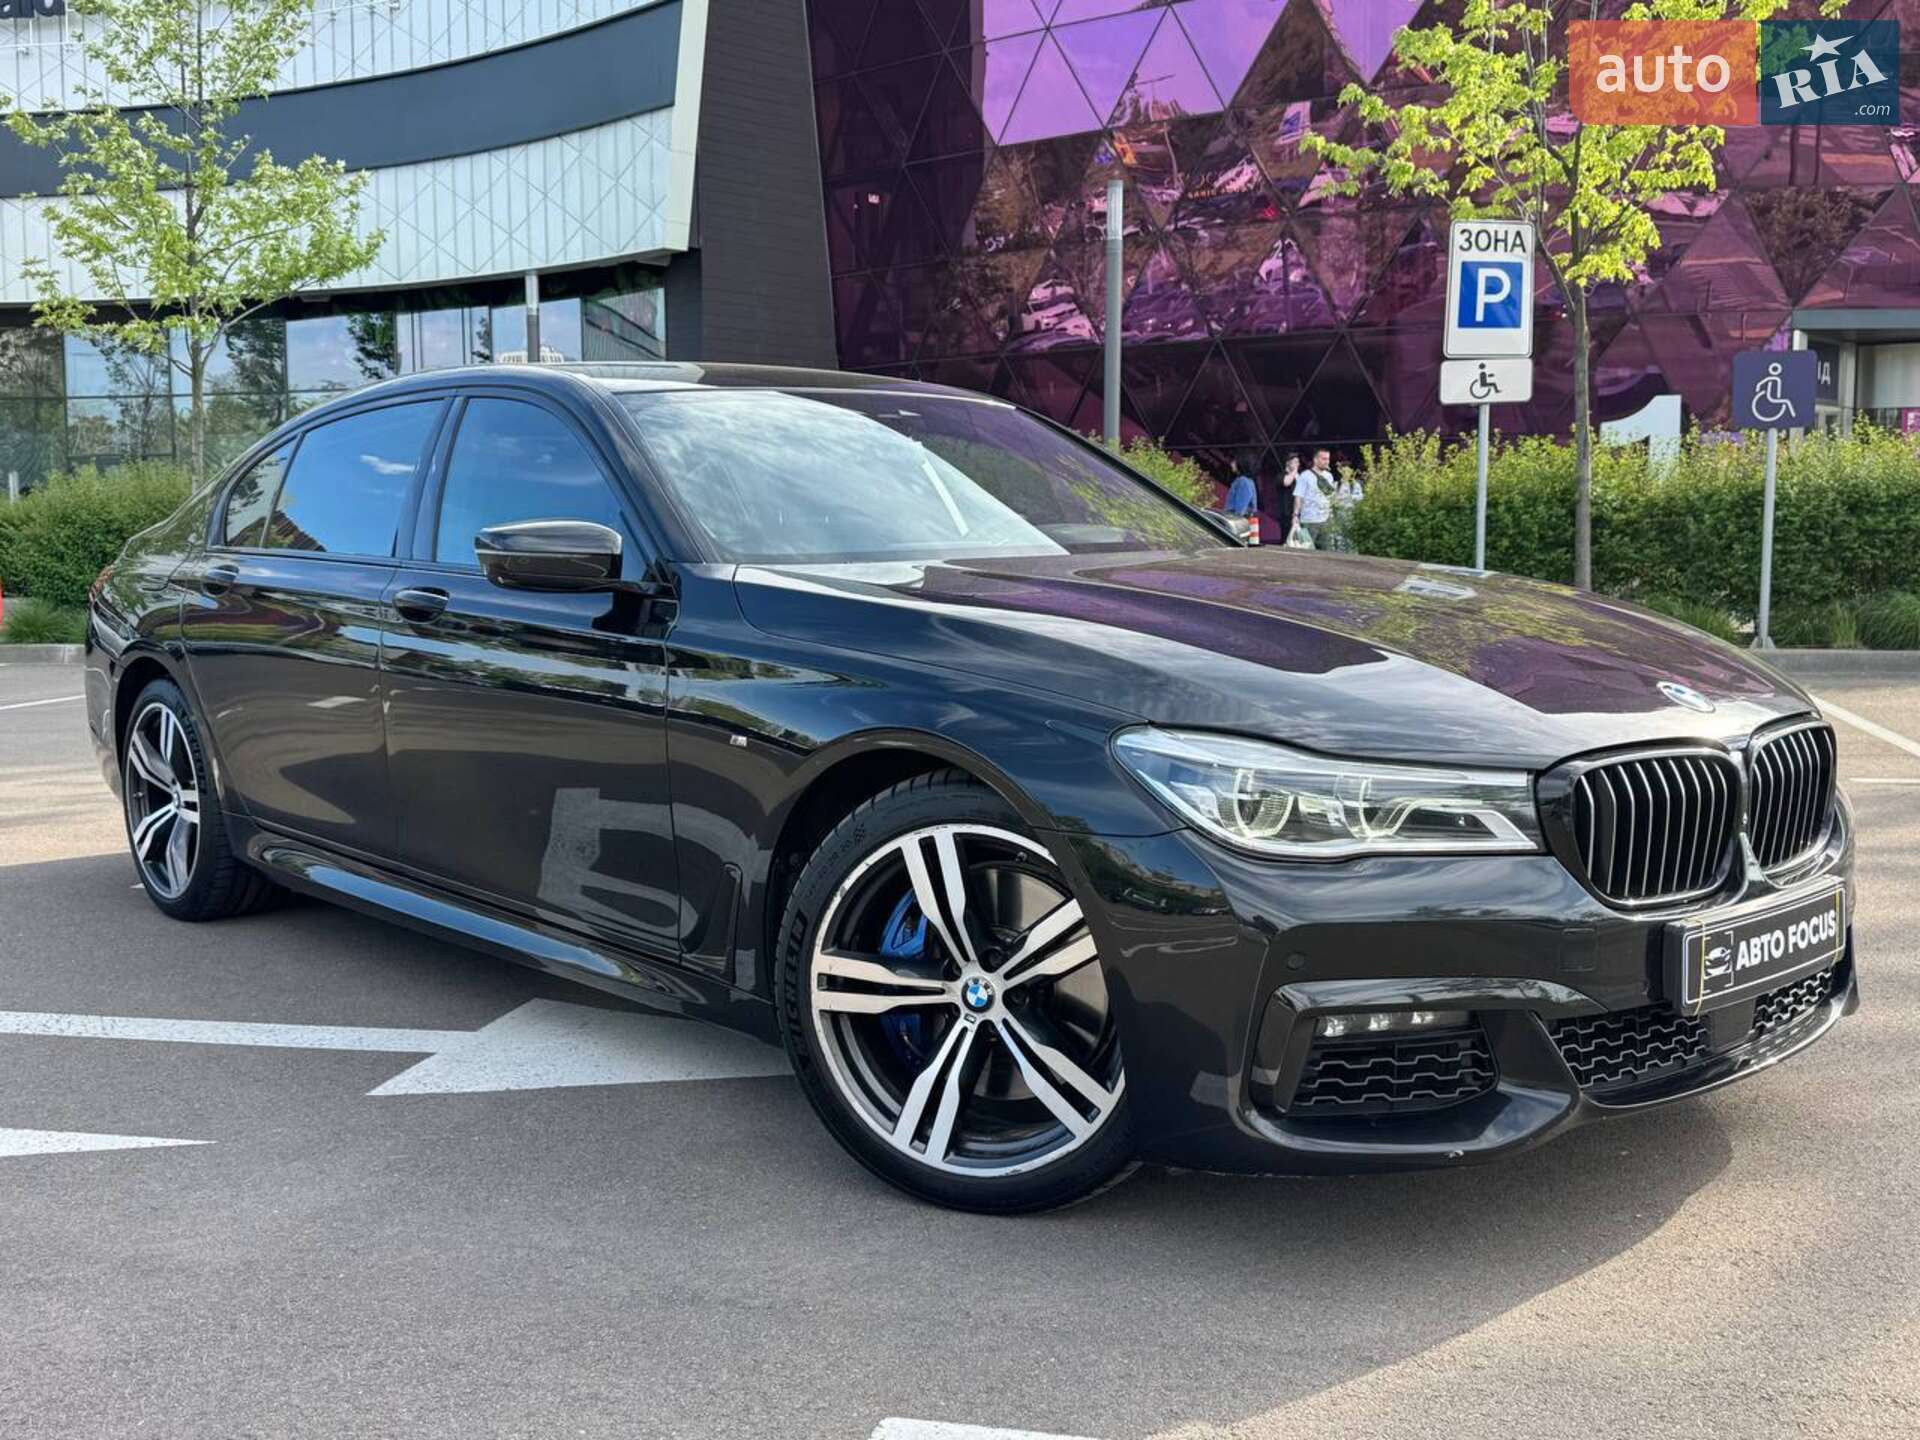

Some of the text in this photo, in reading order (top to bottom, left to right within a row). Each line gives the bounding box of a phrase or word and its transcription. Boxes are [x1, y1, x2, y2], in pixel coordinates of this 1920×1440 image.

[1459, 229, 1527, 253] ЗОНА
[1475, 267, 1511, 322] P
[1735, 909, 1836, 971] АВТО FOCUS
